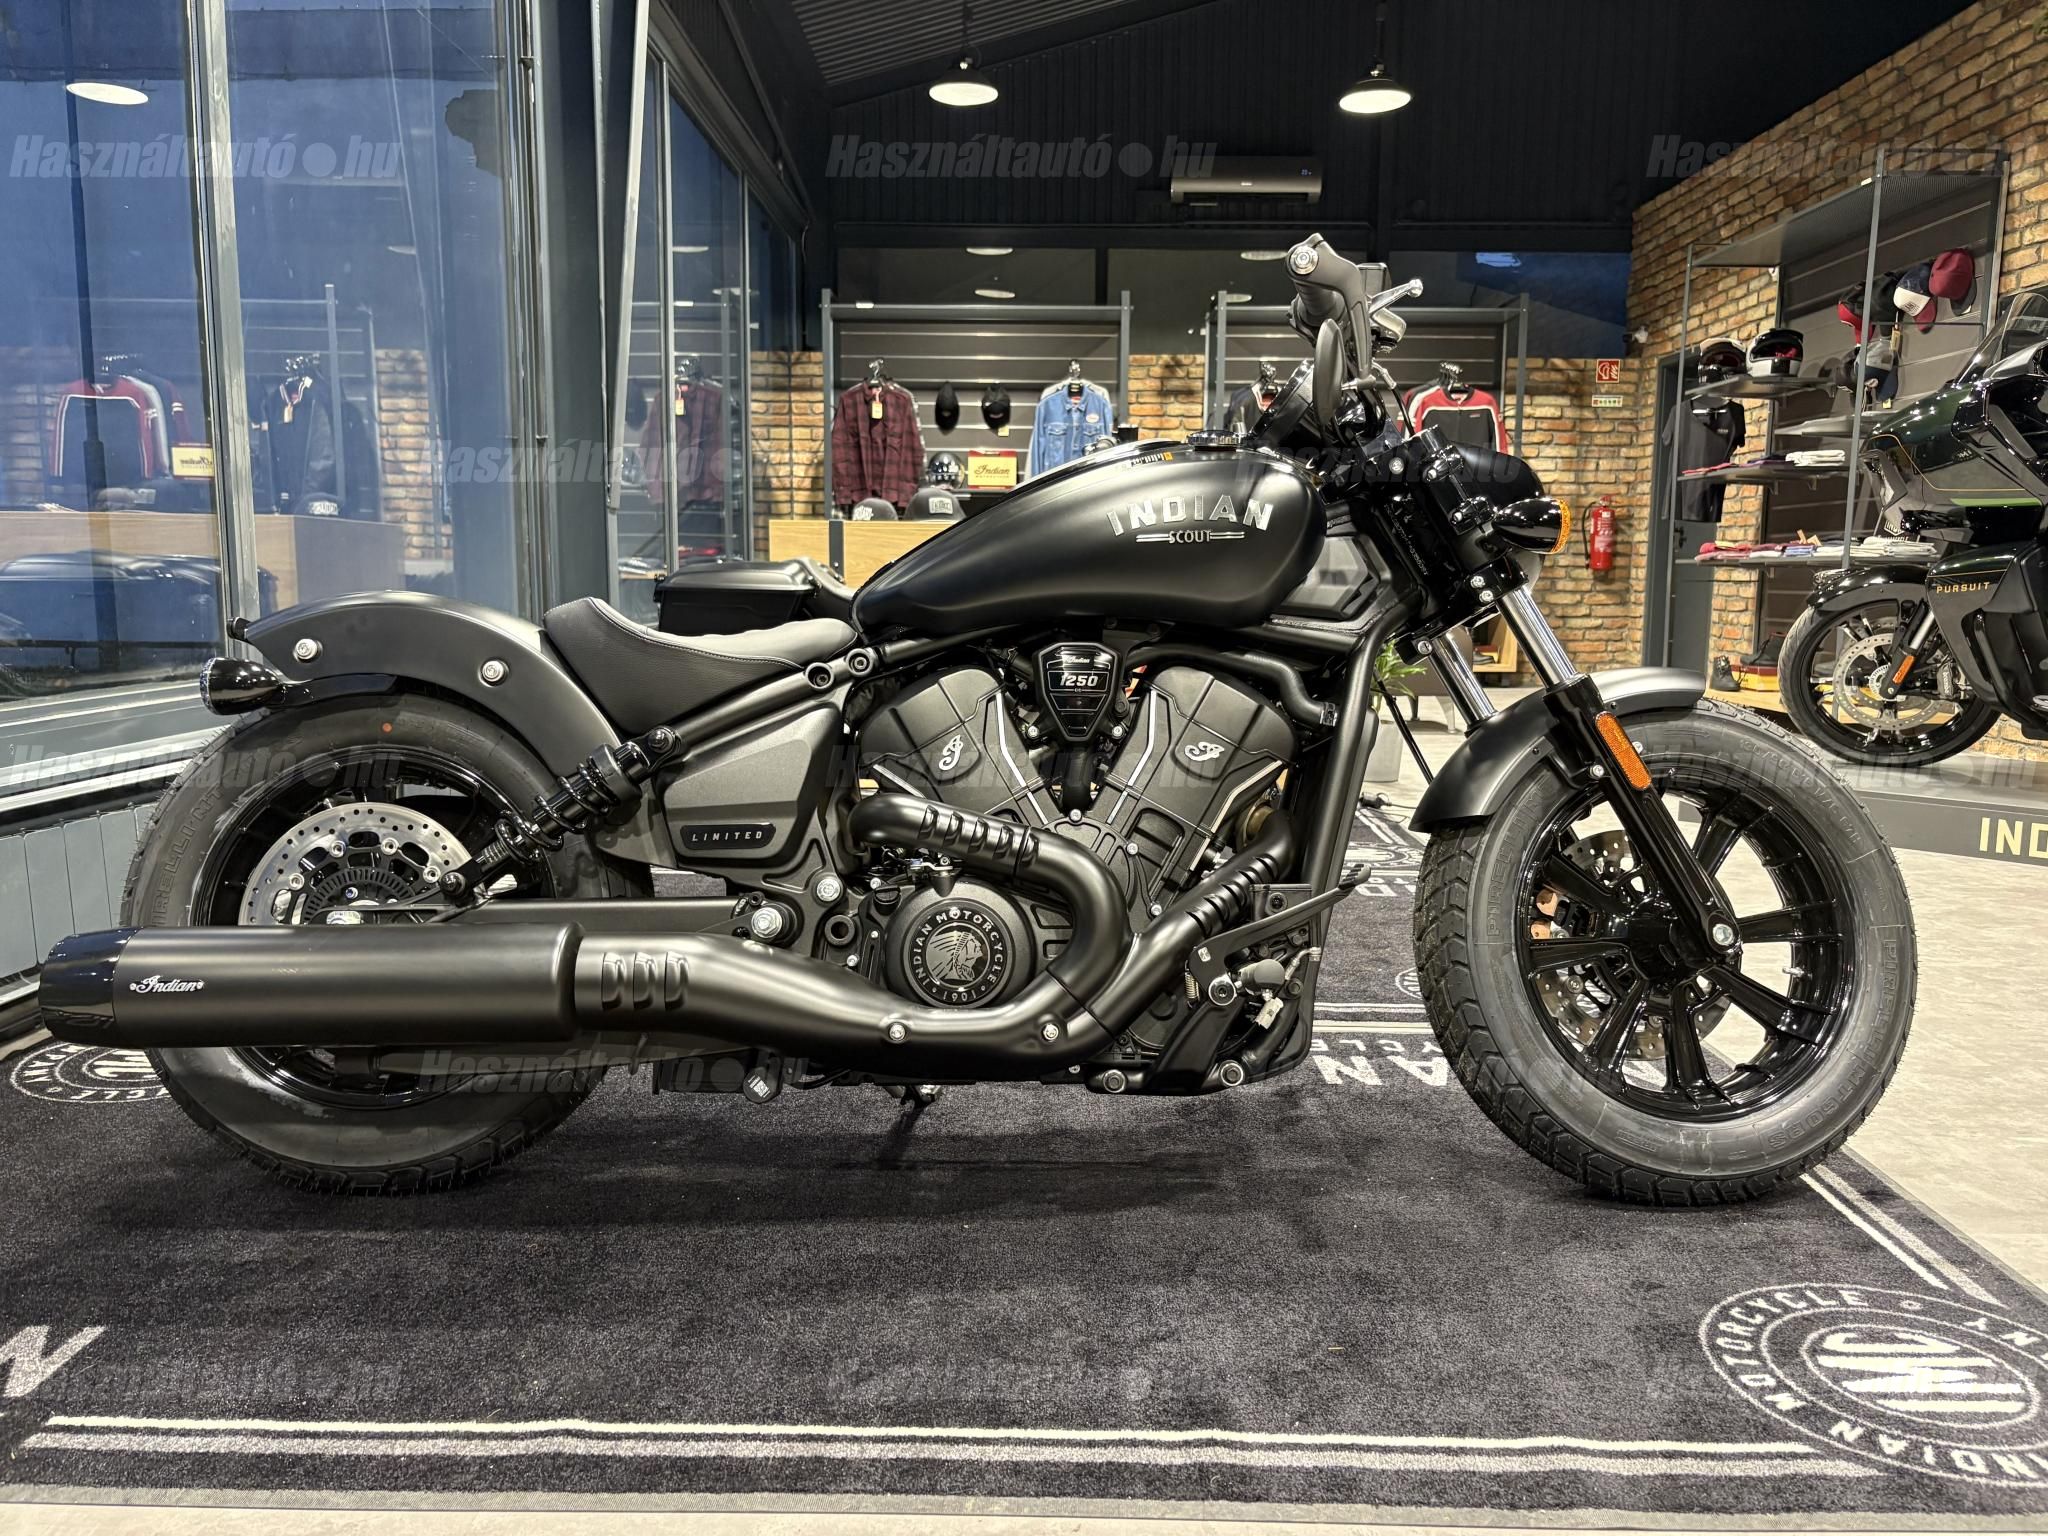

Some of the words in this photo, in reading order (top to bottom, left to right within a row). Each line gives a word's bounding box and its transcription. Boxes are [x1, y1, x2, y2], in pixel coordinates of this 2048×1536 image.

[973, 464, 1011, 475] Indian
[1106, 494, 1274, 536] INDIAN
[1168, 529, 1212, 544] SCOUT
[1936, 581, 1991, 595] PURSUIT
[1060, 675, 1099, 687] 1250
[691, 831, 763, 842] LIMITED
[913, 924, 934, 986] INDIAN
[935, 906, 1003, 984] MOTORCYCLE
[134, 974, 197, 994] Indian
[942, 990, 978, 1003] 1901
[1715, 1288, 1870, 1413] MOTORCYCLE
